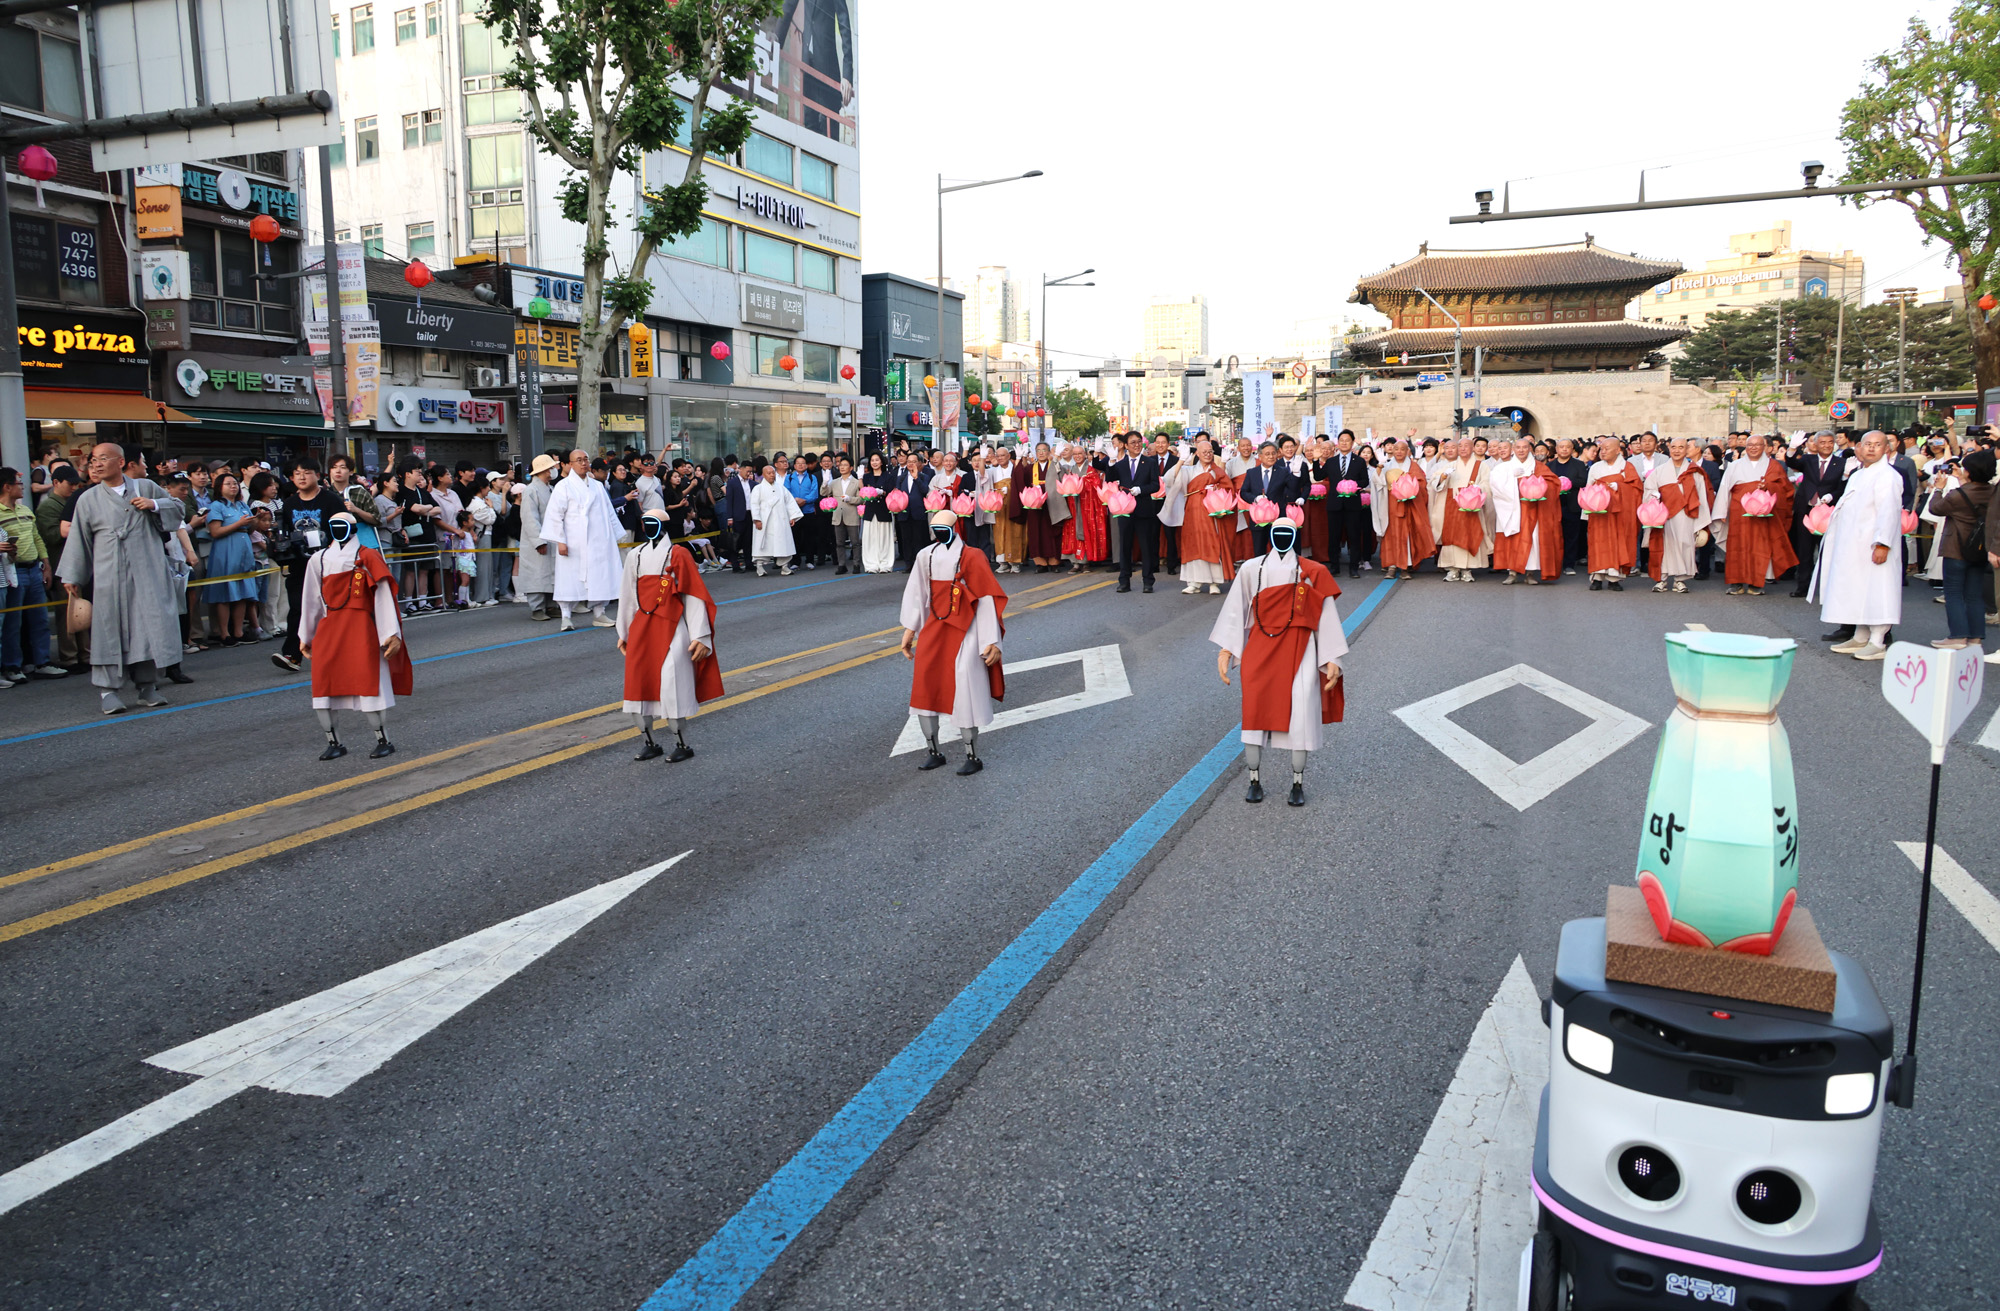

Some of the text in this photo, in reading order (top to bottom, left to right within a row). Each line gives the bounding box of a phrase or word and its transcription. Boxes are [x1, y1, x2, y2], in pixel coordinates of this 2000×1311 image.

[181, 169, 298, 221] 샘플 제작실
[137, 198, 171, 215] Sense
[755, 191, 805, 229] BUTTON
[139, 226, 148, 234] 2F
[220, 215, 238, 225] Sense
[238, 218, 251, 229] Mod
[71, 231, 94, 248] 02)
[62, 246, 95, 262] 747-
[61, 262, 97, 279] 4396
[1673, 269, 1781, 291] Hotel Dongdaemun
[150, 321, 176, 332] 의료기
[406, 308, 454, 332] Liberty
[17, 324, 136, 354] re pizza
[416, 331, 438, 342] tailor
[517, 350, 527, 360] 10
[530, 350, 538, 360] 10
[418, 397, 505, 424] 한국의료기
[1649, 812, 1685, 866] 망
[1666, 1272, 1736, 1307] 연등회
